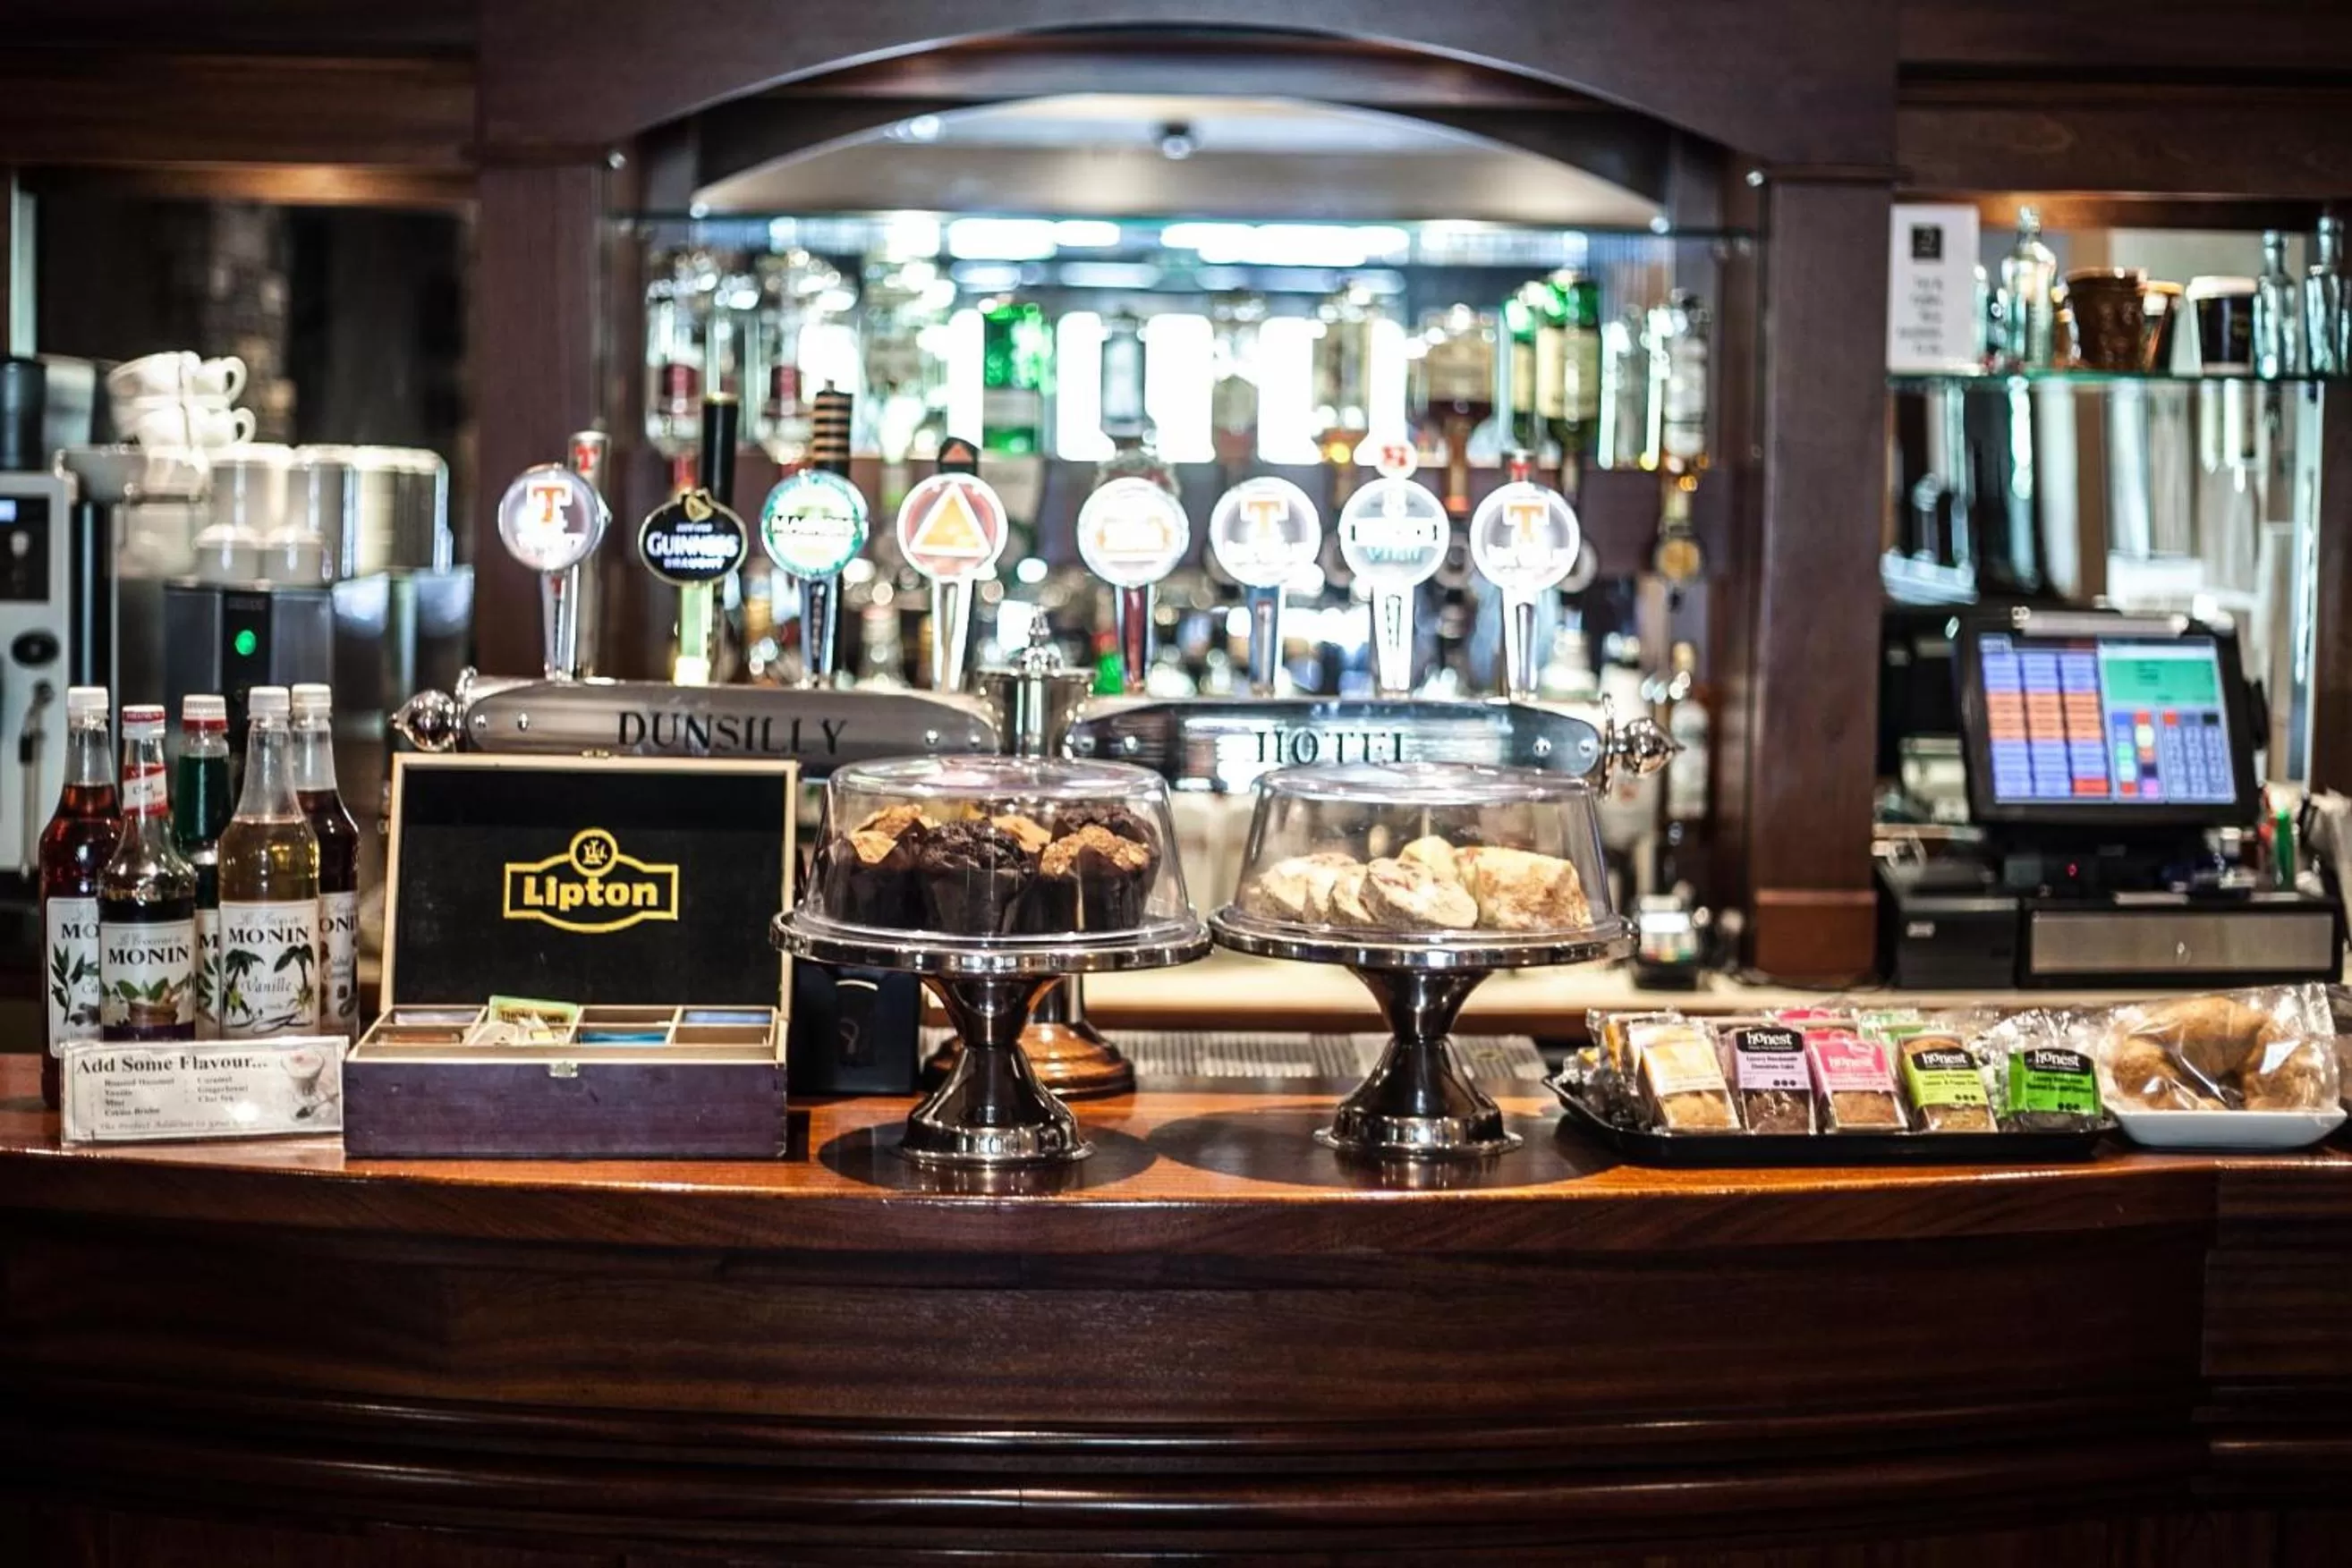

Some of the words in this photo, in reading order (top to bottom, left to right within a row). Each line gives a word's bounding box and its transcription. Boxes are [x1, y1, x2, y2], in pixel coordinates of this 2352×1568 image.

[618, 710, 848, 755] DUNSILLY
[523, 876, 658, 911] Lipton
[228, 926, 310, 945] MONIN
[108, 945, 190, 966] MONIN
[1746, 1031, 1793, 1046] honest
[77, 1055, 115, 1073] Add
[122, 1055, 173, 1073] Some
[2034, 1050, 2080, 1067] honest
